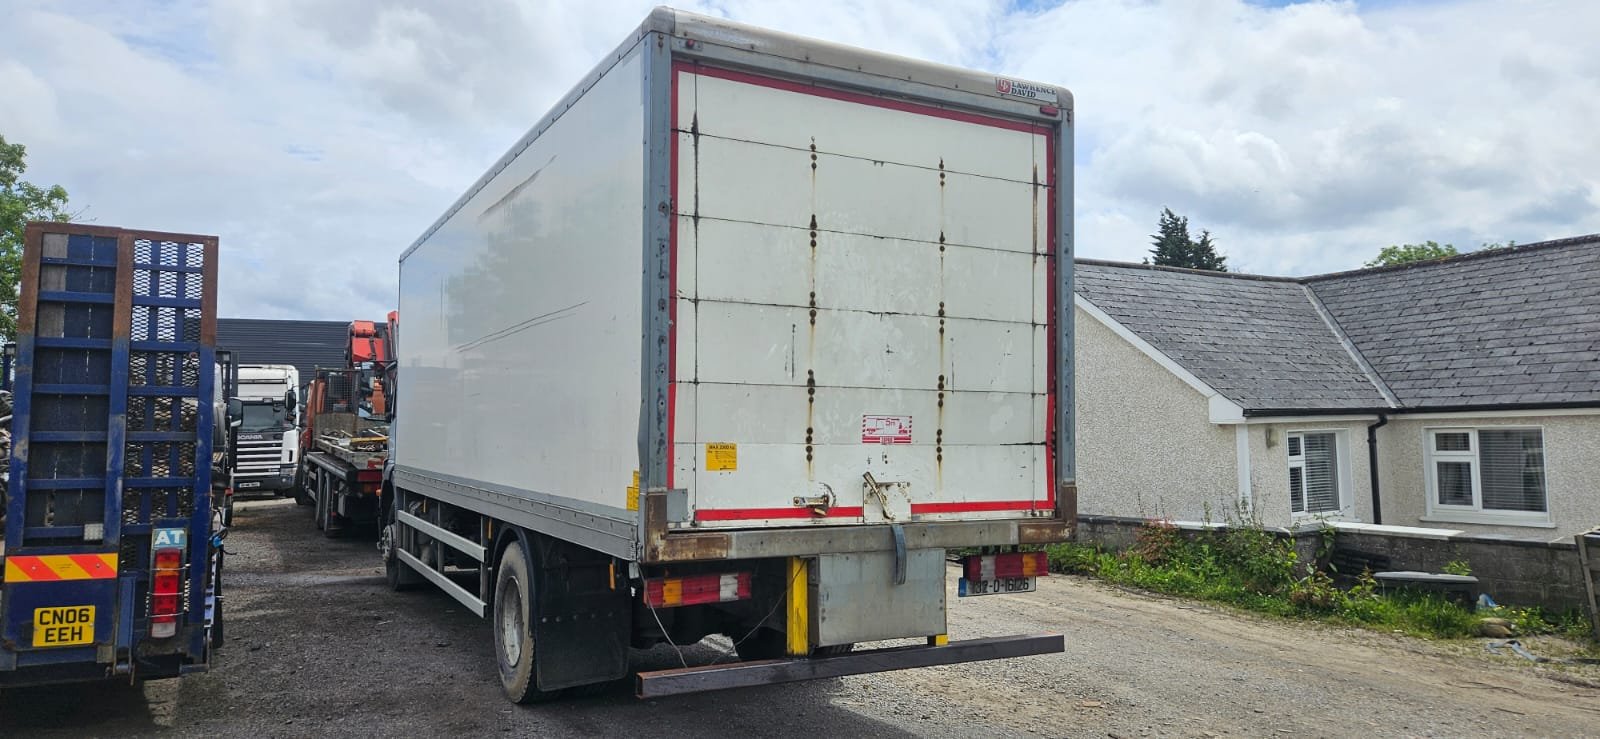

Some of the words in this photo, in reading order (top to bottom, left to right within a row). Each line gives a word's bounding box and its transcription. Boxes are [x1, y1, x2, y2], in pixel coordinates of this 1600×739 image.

[1011, 88, 1036, 98] DAVID
[1012, 81, 1057, 95] LAWRENCE
[155, 530, 184, 544] AT
[40, 608, 90, 625] CN06
[45, 626, 82, 642] EEH
